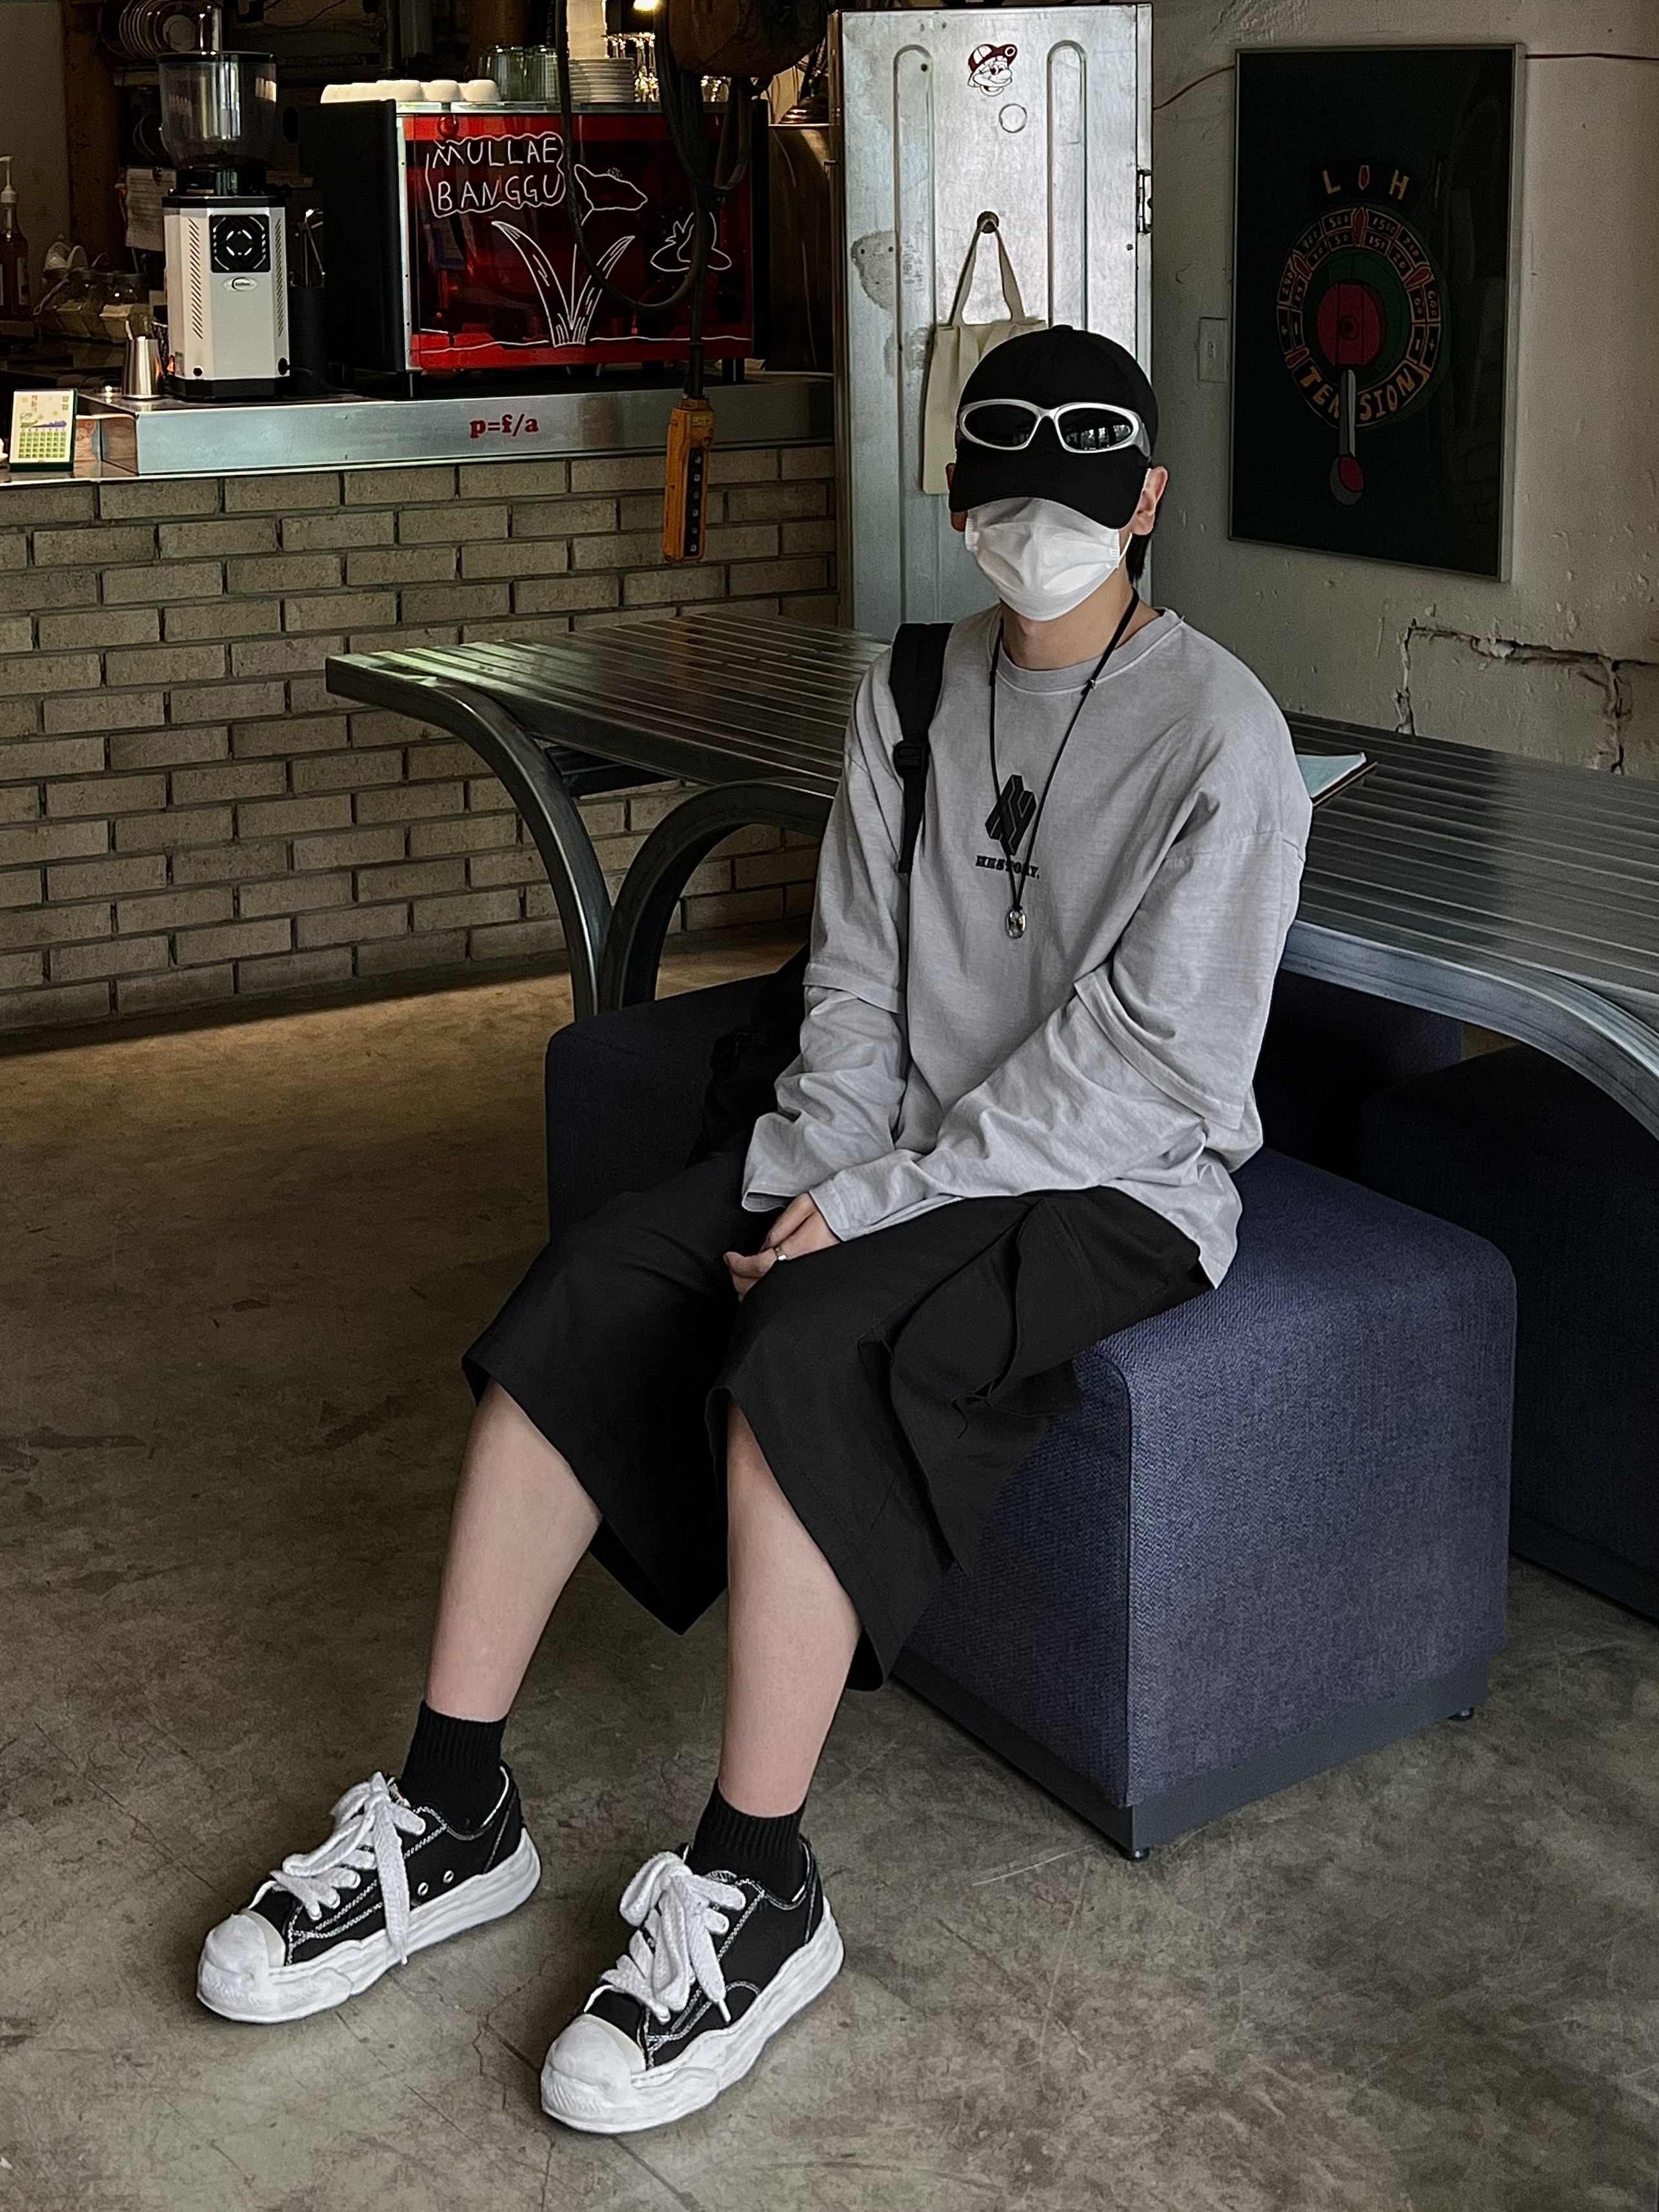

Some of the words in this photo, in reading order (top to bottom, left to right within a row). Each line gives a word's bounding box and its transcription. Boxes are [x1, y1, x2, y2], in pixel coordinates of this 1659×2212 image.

[432, 138, 558, 168] MULLAE
[439, 174, 561, 212] BANGGU
[1300, 367, 1416, 421] TENSION
[469, 414, 539, 438] p=f/a
